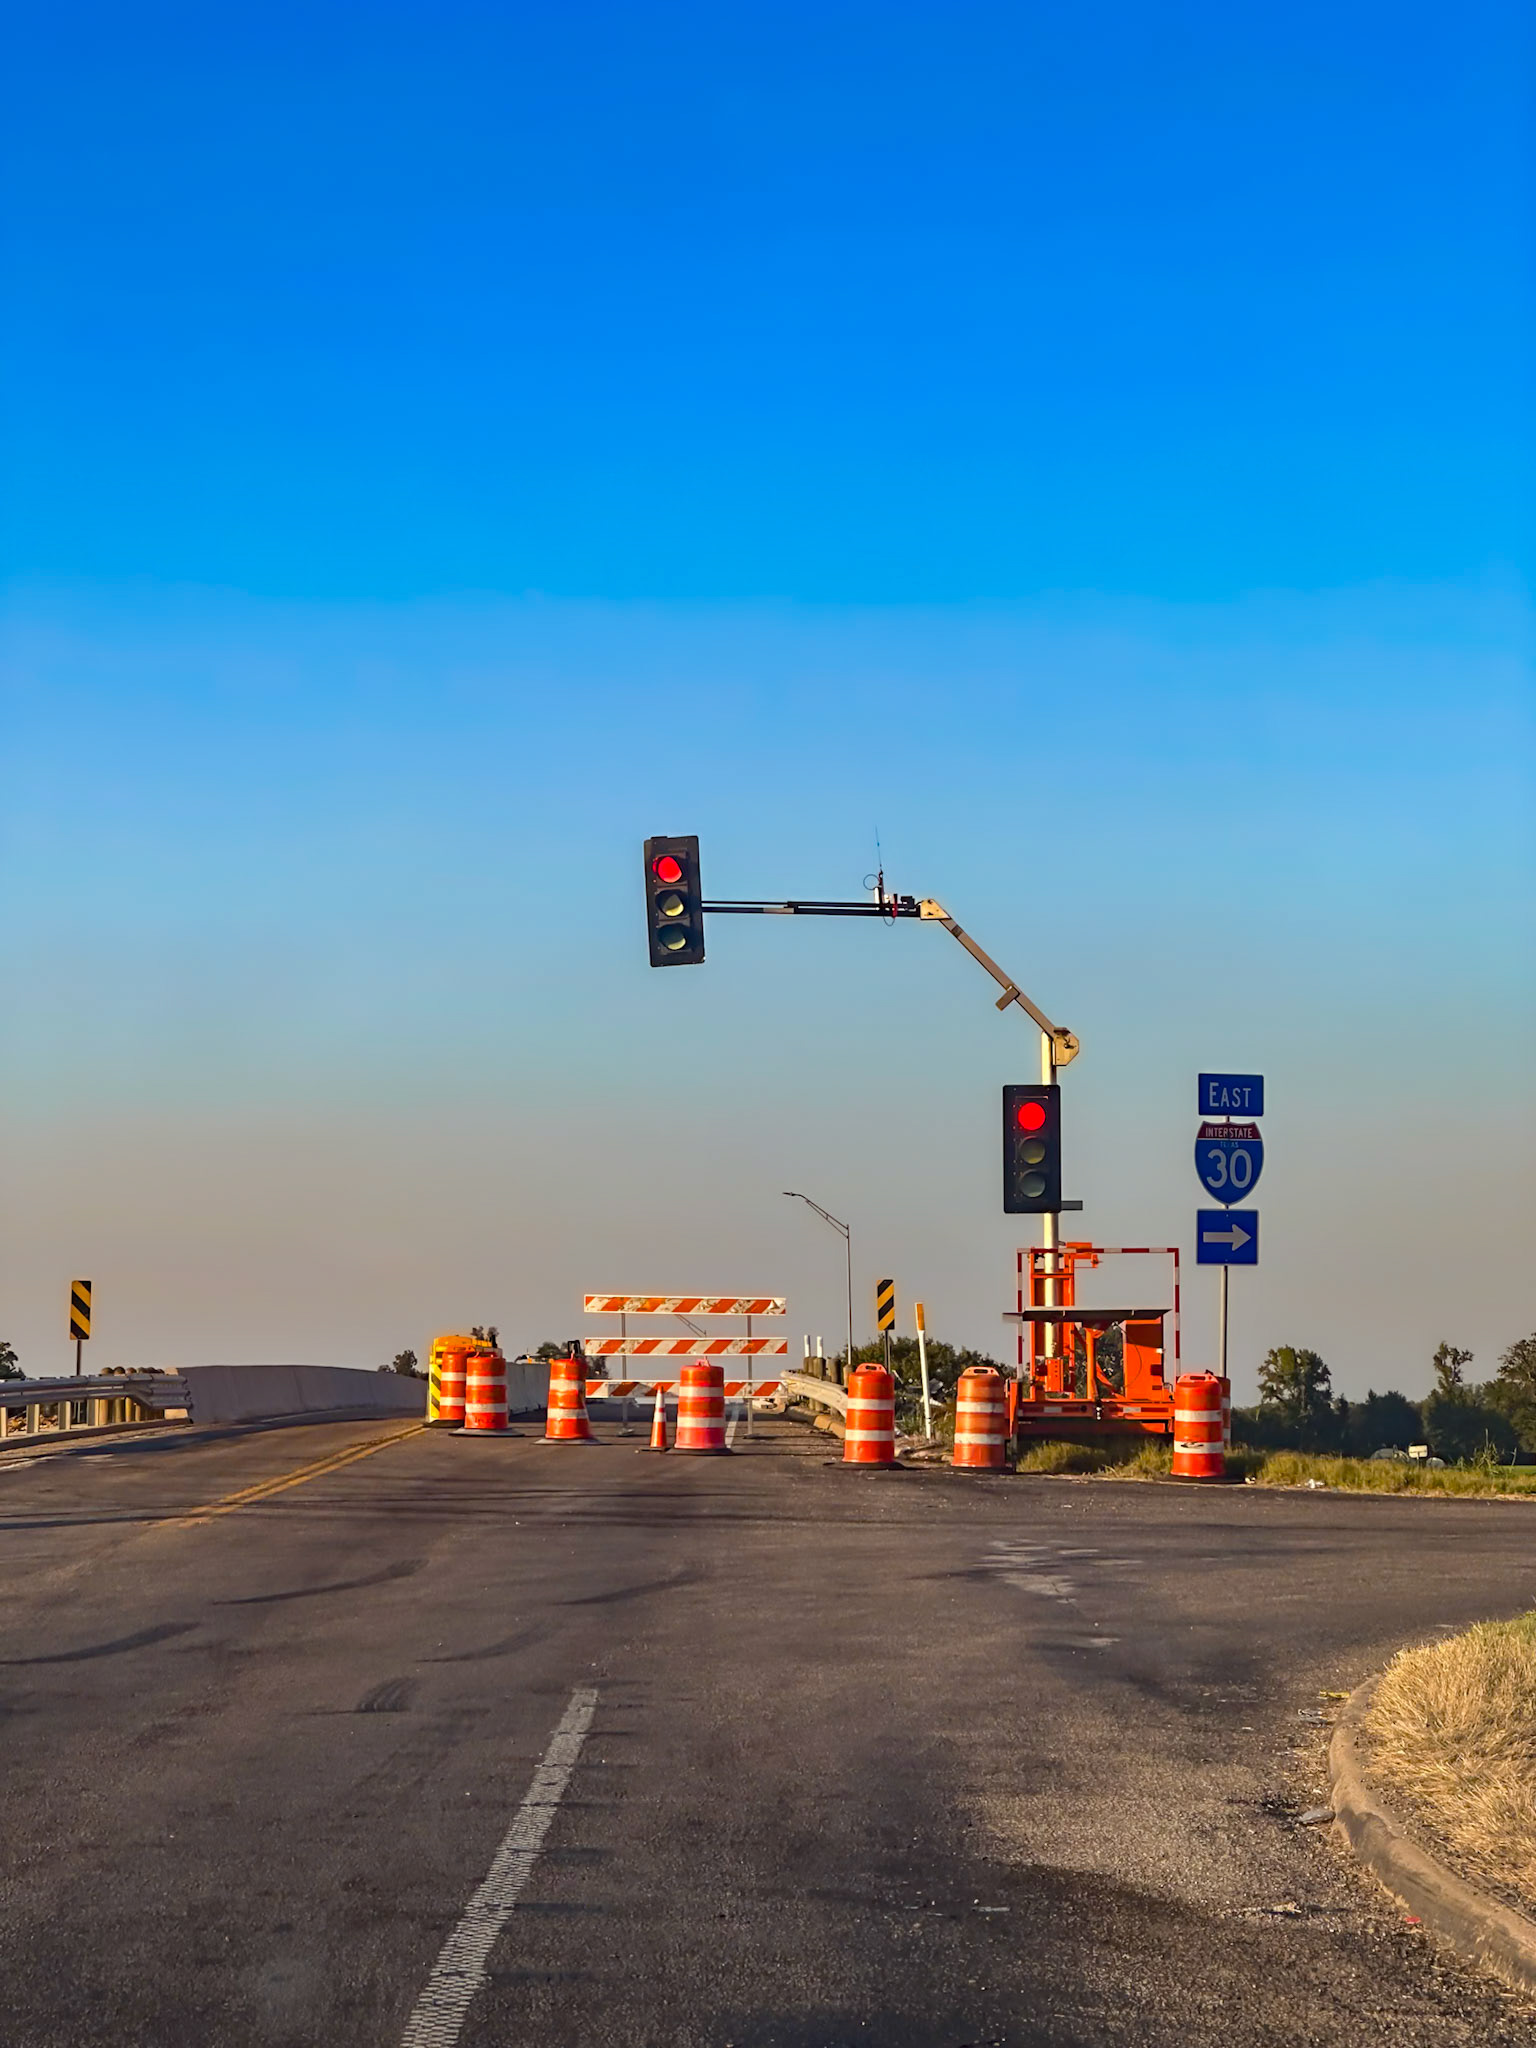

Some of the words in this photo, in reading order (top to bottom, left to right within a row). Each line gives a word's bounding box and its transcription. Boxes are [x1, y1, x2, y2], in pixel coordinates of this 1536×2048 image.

[1209, 1082, 1251, 1107] EAST
[1205, 1127, 1253, 1138] INTERSTATE
[1206, 1148, 1252, 1189] 30
